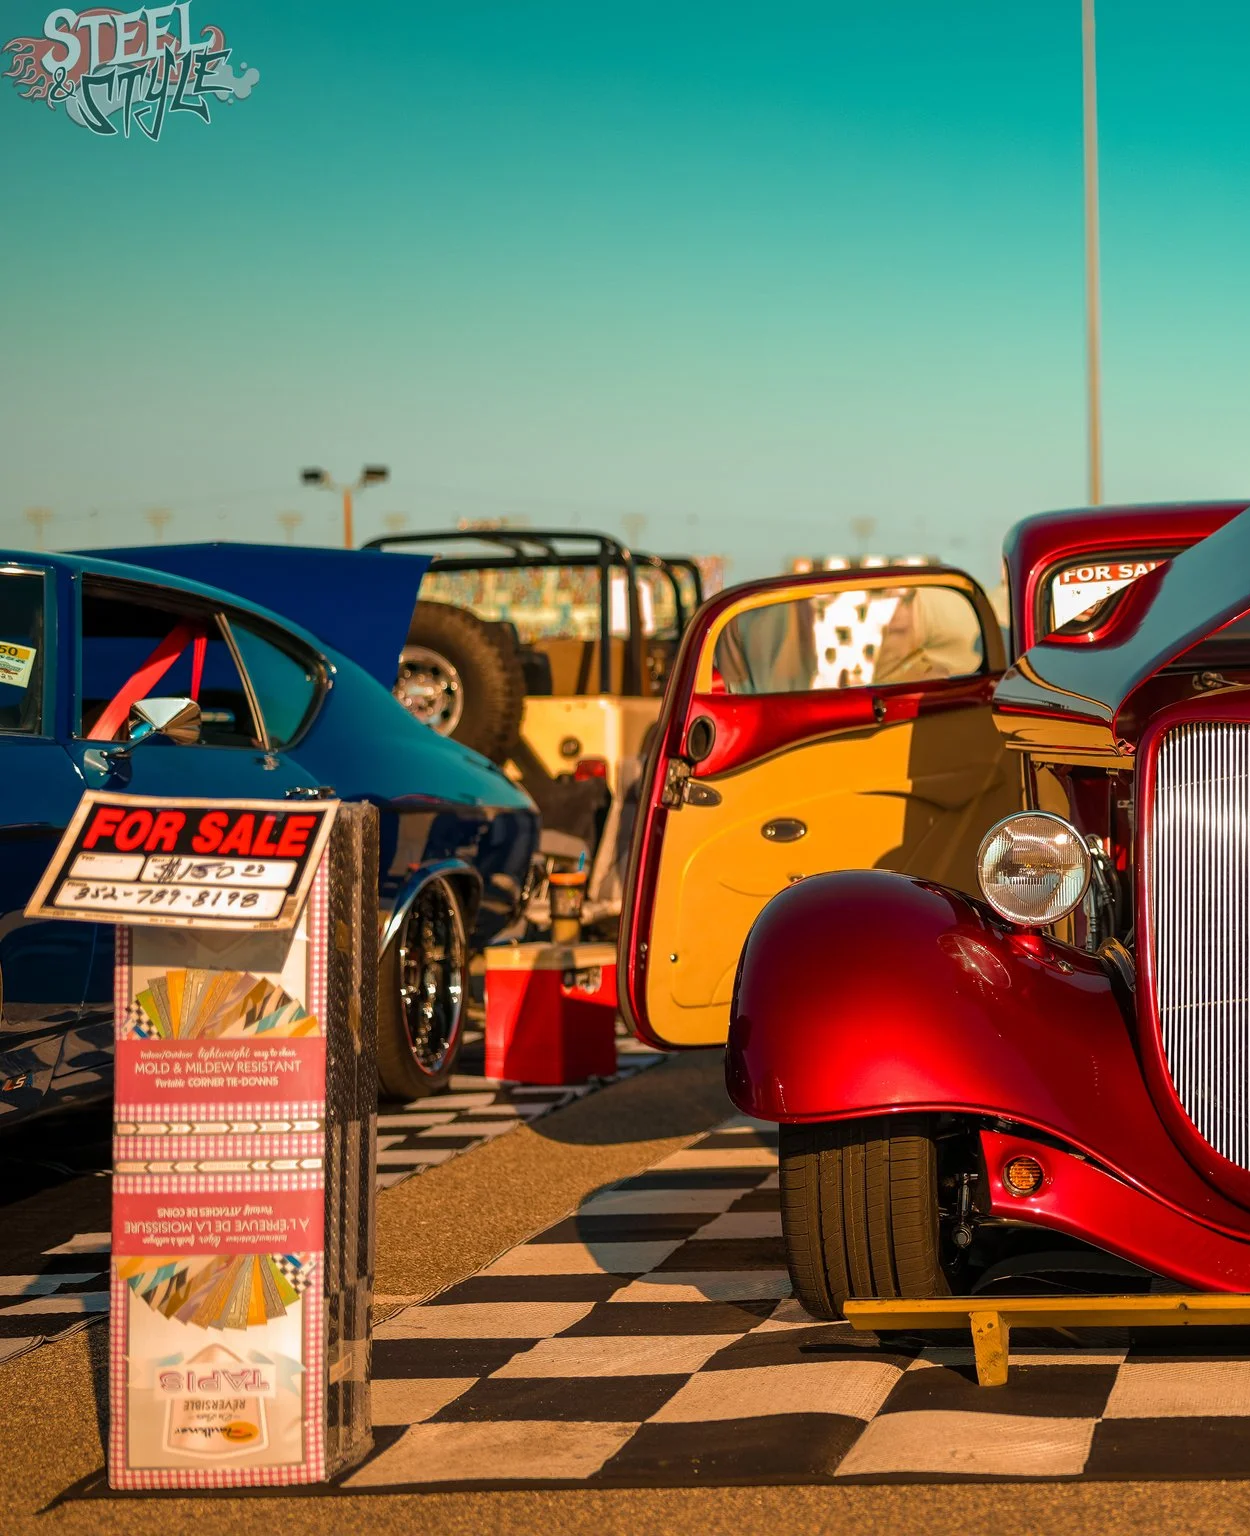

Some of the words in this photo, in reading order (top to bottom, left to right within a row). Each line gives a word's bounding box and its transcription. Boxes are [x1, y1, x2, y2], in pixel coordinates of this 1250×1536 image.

[1063, 565, 1113, 583] FOR
[82, 807, 187, 853] FOR
[192, 810, 317, 857] SALE
[135, 1062, 170, 1075] MOLD
[173, 1062, 182, 1074] &
[185, 1061, 234, 1075] MILDEW
[237, 1059, 302, 1073] RESISTANT
[155, 1077, 185, 1089] Portable
[188, 1076, 224, 1088] CORNER
[226, 1075, 279, 1087] TIE-DOWNS
[157, 1207, 186, 1219] COINS
[186, 1207, 198, 1218] DE
[199, 1205, 242, 1218] ATTACHES
[124, 1220, 193, 1235] MOISISSURE
[196, 1219, 212, 1233] LA
[215, 1219, 231, 1233] DE
[234, 1217, 296, 1233] L'ÉPREUVE
[158, 1367, 270, 1393] TAPIS
[183, 1399, 246, 1412] RÉVERSIBLE
